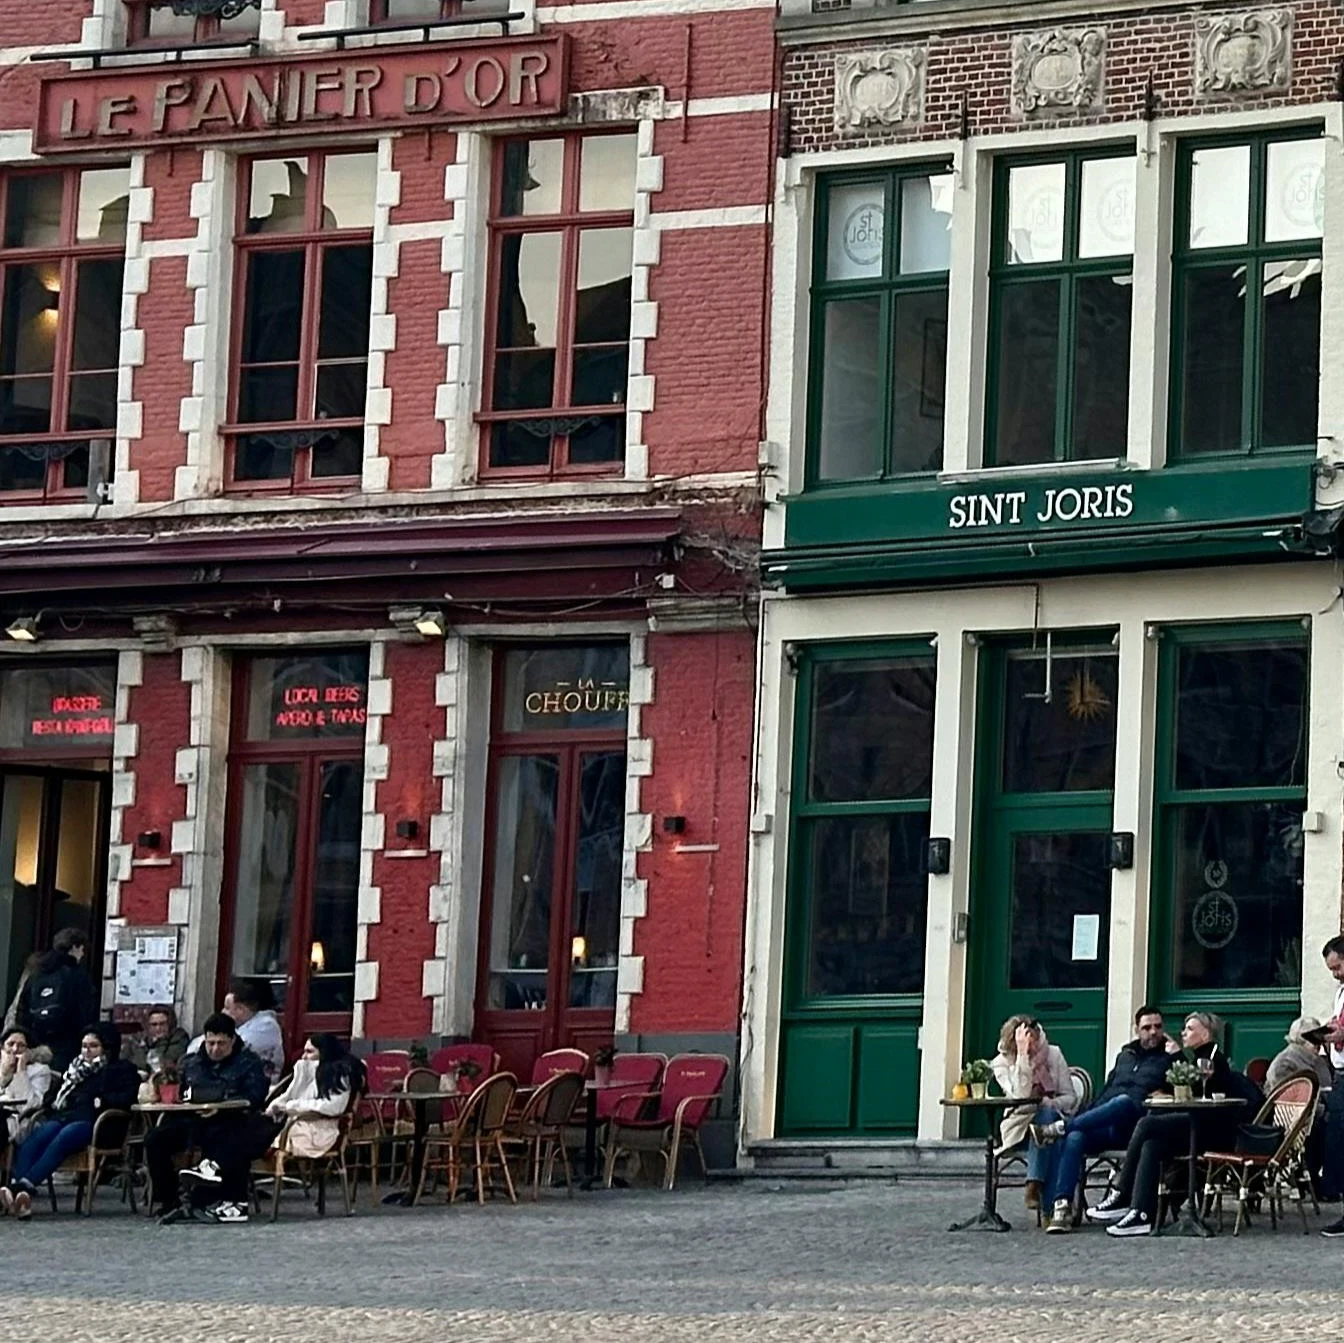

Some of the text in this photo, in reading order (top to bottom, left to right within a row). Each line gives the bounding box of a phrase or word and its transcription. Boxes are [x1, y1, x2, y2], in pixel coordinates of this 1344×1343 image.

[60, 50, 550, 140] LE PANIER D'OR
[949, 484, 1133, 528] SINT JORIS
[578, 677, 595, 690] LA
